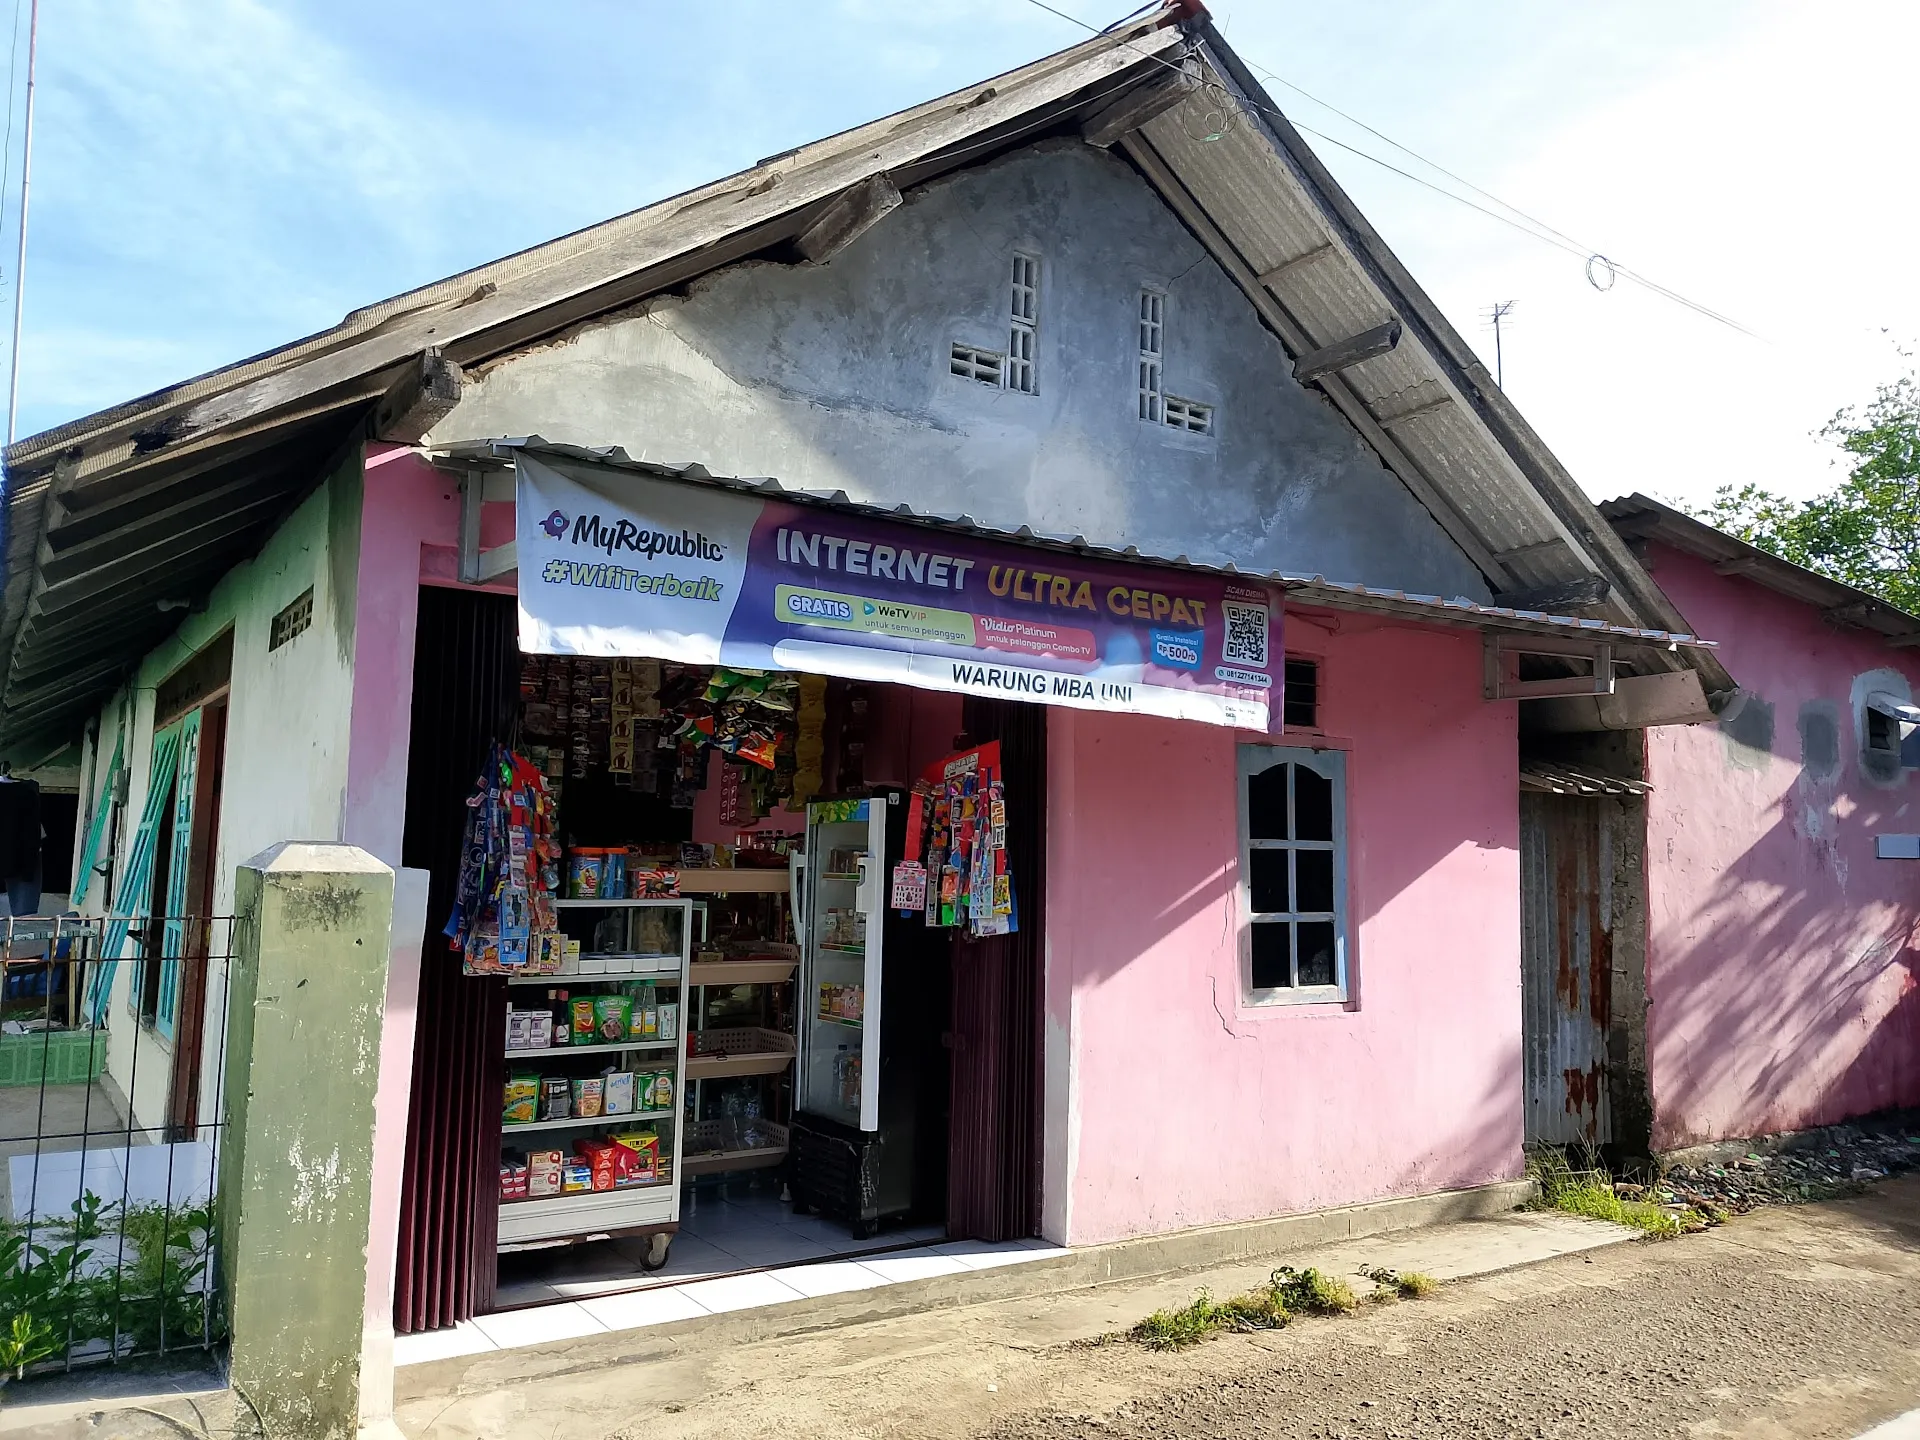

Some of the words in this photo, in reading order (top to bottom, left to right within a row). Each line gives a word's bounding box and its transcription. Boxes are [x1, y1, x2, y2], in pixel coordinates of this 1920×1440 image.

[542, 559, 723, 601] #WifiTerbaik
[776, 528, 976, 590] INTERNET
[988, 565, 1097, 612] ULTRA
[1106, 586, 1206, 626] CEPAT
[788, 594, 851, 619] GRATIS
[865, 619, 889, 629] untuk
[891, 624, 920, 634] semua
[921, 625, 966, 642] pelanggan
[980, 617, 1016, 633] Vidio
[1016, 623, 1057, 640] Platinum
[986, 634, 1009, 645] untuk
[1009, 638, 1051, 652] pelanggan
[1052, 642, 1080, 654] Combo
[1080, 646, 1091, 655] TV
[952, 664, 1046, 694] WARUNG
[1053, 677, 1095, 701] MBA
[1226, 670, 1268, 684] 081227141344
